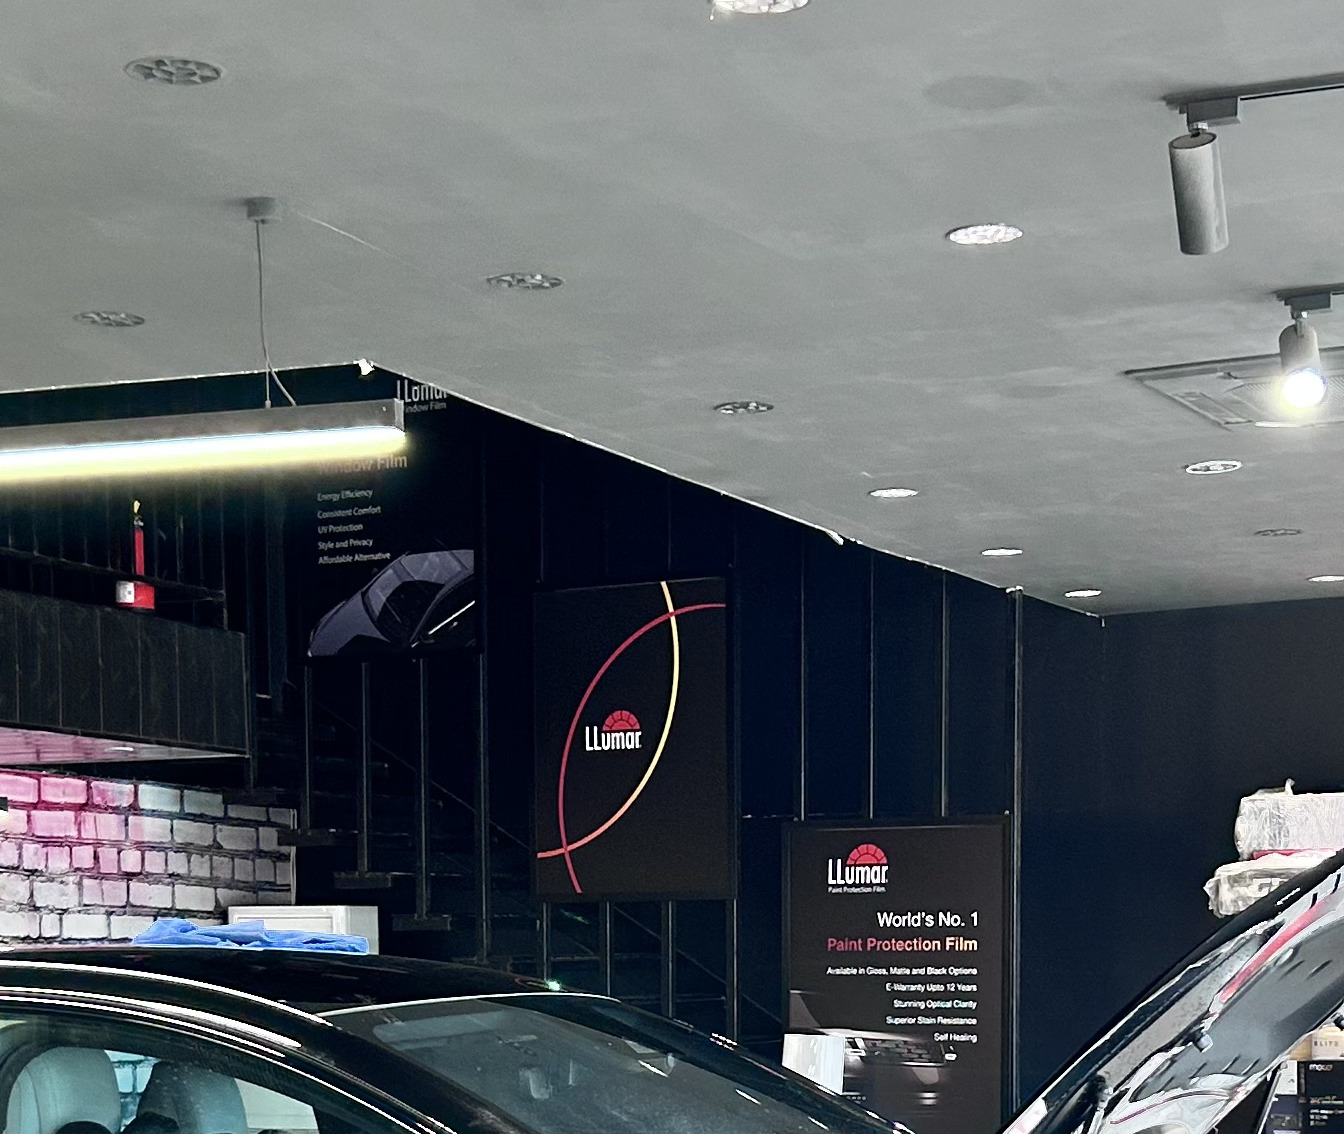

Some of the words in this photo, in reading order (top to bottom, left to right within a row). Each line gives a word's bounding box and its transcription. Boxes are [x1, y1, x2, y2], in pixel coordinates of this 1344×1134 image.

[328, 524, 363, 533] Protection
[317, 541, 335, 551] Style
[349, 539, 373, 547] Privacy
[585, 725, 642, 751] LLumar
[827, 858, 889, 885] LLumar
[877, 911, 935, 927] World's
[938, 911, 965, 927] No.
[970, 911, 979, 926] 1
[827, 938, 863, 951] Paint
[867, 937, 941, 951] Protection
[945, 936, 978, 951] Film
[826, 967, 857, 975] Available
[890, 967, 910, 975] Matte
[912, 967, 925, 975] and
[927, 967, 947, 975] Black
[948, 967, 978, 976] Options
[886, 983, 925, 993] E-Warranty
[926, 983, 945, 993] Upto
[946, 983, 955, 991] 12
[956, 983, 978, 991] Years
[893, 1000, 925, 1009] Stunning
[926, 1000, 952, 1009] Optical
[953, 1000, 977, 1009] Clarity
[886, 1016, 916, 1025] Superior
[917, 1016, 936, 1024] Stain
[937, 1016, 978, 1025] Resistance
[934, 1033, 948, 1041] Self
[949, 1033, 978, 1043] Healing
